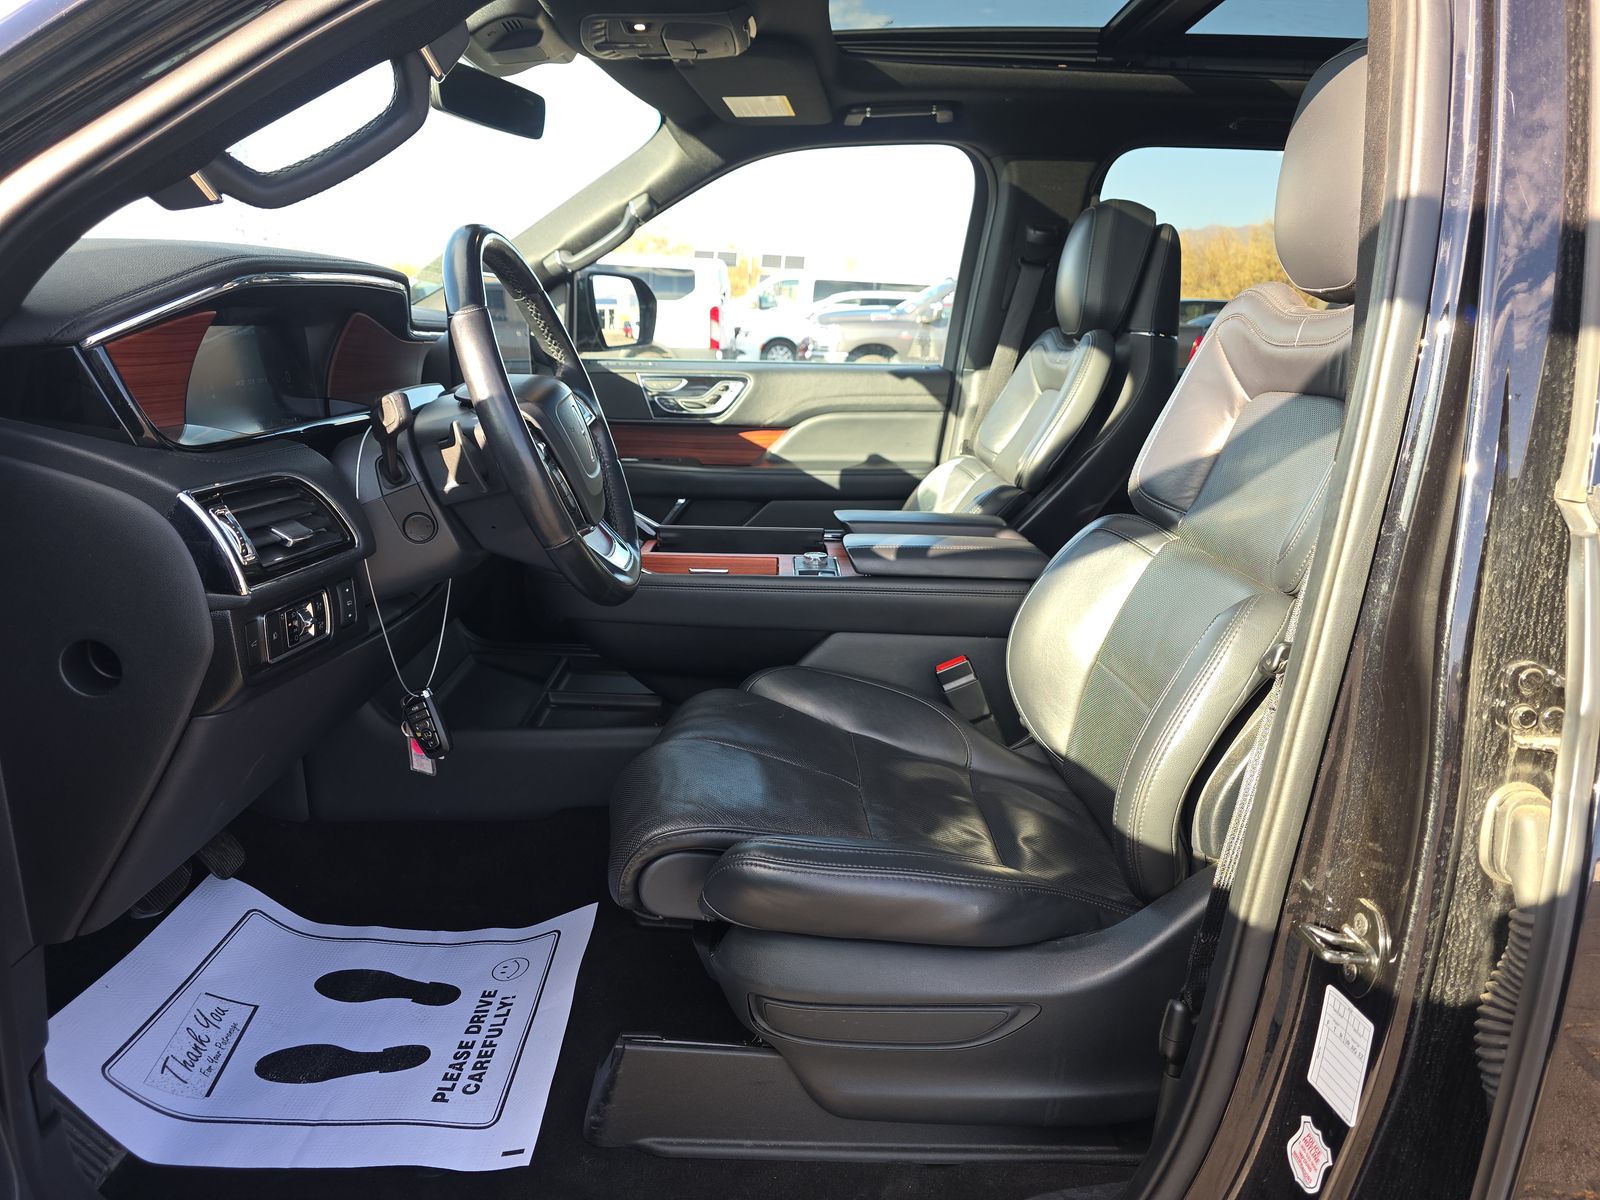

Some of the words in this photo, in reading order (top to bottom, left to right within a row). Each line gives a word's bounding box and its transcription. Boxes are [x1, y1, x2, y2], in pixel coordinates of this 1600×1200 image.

[161, 1026, 210, 1084] Thank
[194, 1006, 229, 1029] You
[200, 1065, 214, 1077] For
[207, 1051, 222, 1064] Your
[431, 1040, 476, 1103] PLEASE
[464, 989, 498, 1034] DRIVE
[462, 995, 516, 1095] CAREFULLY!
[1307, 1132, 1321, 1156] POLICE
